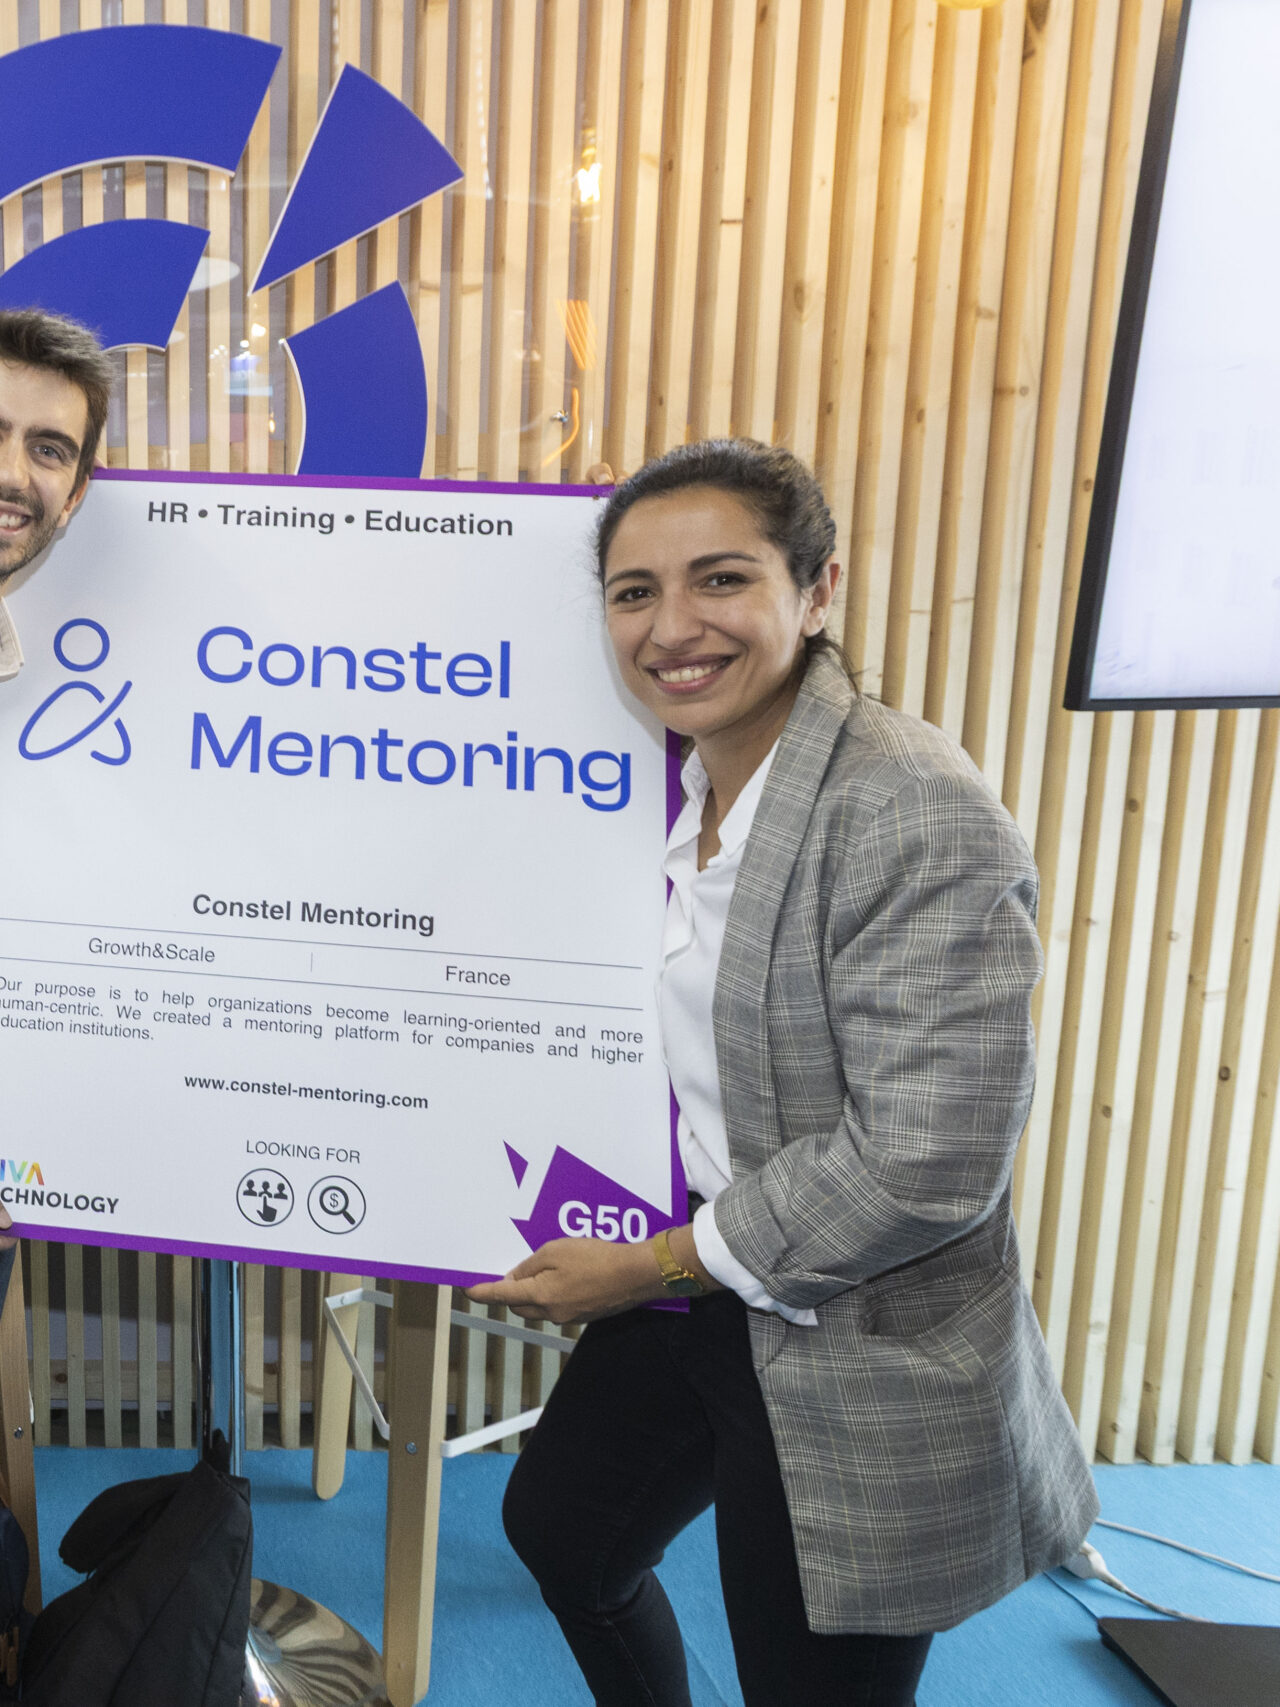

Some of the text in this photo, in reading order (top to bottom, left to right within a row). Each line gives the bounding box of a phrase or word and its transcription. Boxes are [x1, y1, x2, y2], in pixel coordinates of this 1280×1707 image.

[147, 501, 514, 537] HR Training Education
[197, 626, 511, 698] Constel
[190, 711, 631, 812] Mentoring
[192, 893, 435, 938] Constel Mentoring
[87, 937, 216, 964] Growth&Scale
[445, 964, 511, 987] France
[34, 982, 96, 998] purpose
[109, 985, 122, 1000] is
[134, 987, 149, 1003] to
[162, 989, 195, 1009] help
[207, 995, 313, 1017] organizations
[326, 1003, 390, 1023] become
[403, 1009, 541, 1036] learning-oriented
[554, 1024, 587, 1040] and
[600, 1028, 644, 1044] more
[69, 1019, 154, 1041] institutions.
[116, 1004, 142, 1021] We
[153, 1008, 211, 1027] created
[222, 1016, 233, 1029] a
[244, 1017, 323, 1040] mentoring
[334, 1024, 400, 1043] platform
[412, 1029, 434, 1046] for
[445, 1034, 535, 1054] companies
[547, 1043, 579, 1059] and
[591, 1045, 644, 1065] higher
[184, 1074, 429, 1110] www.constel-mentoring.com
[245, 1140, 361, 1165] LOOKING FOR
[558, 1200, 648, 1244] G50
